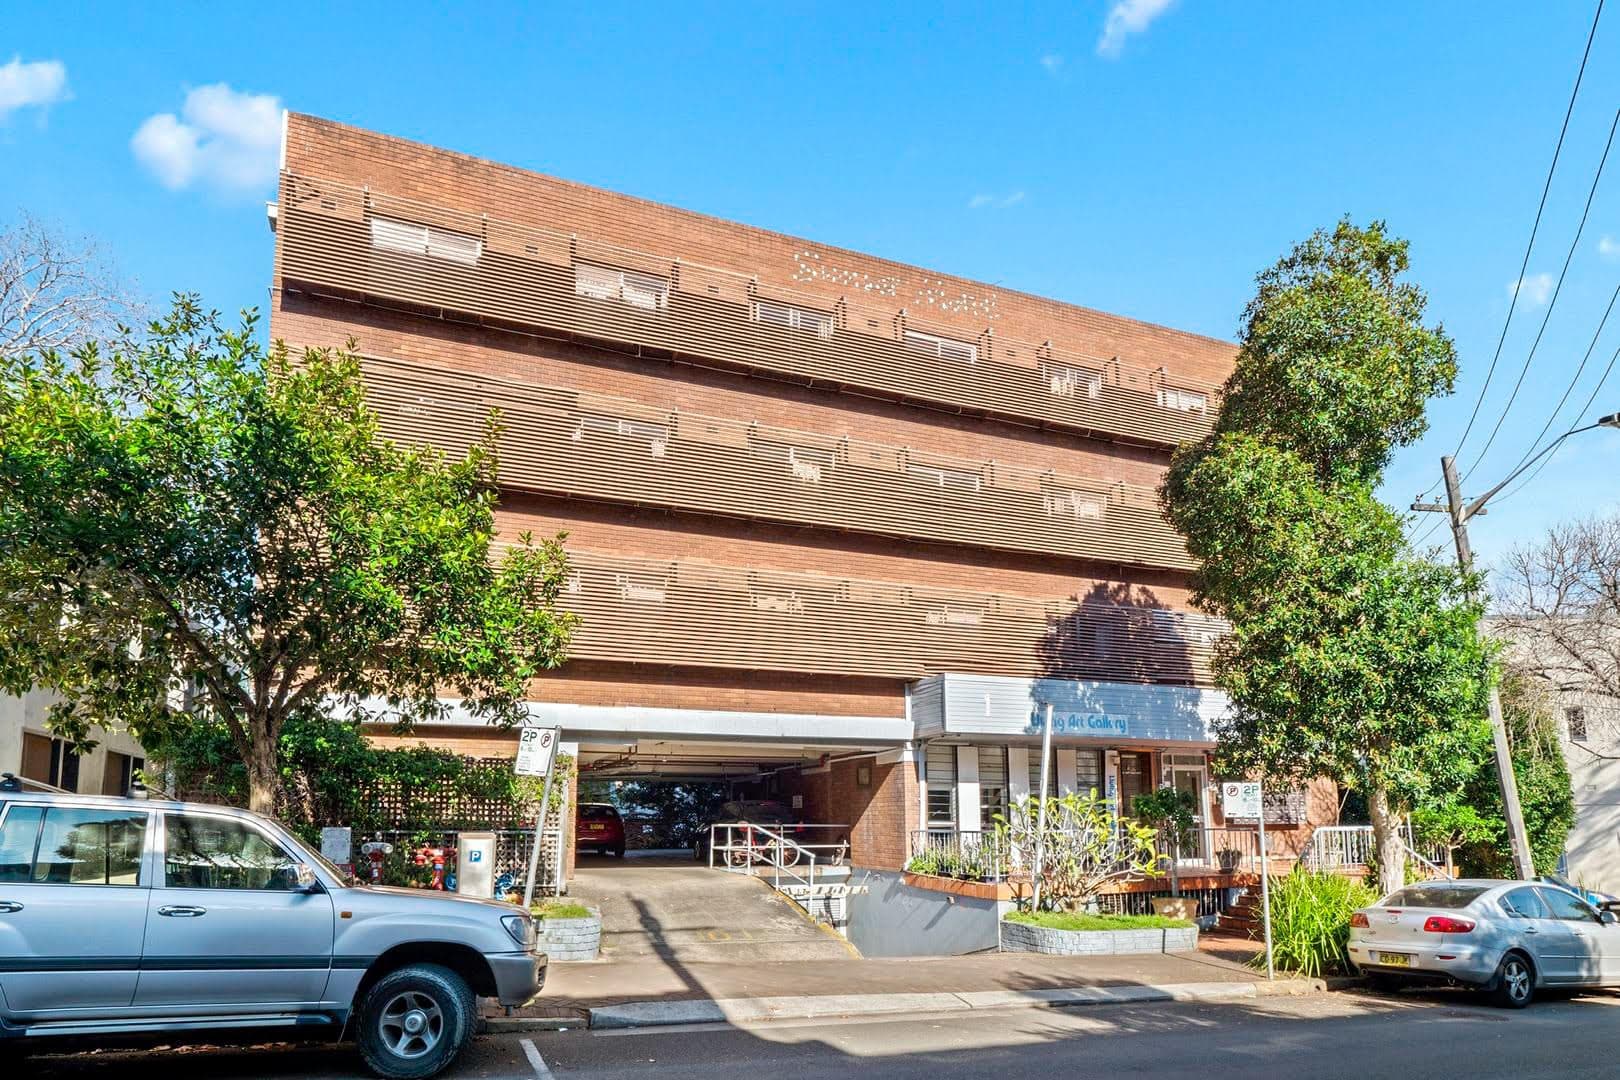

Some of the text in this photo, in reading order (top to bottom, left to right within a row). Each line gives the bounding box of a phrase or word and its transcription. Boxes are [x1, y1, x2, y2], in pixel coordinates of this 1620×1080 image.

[1030, 711, 1126, 733] Livg Art Gallery
[522, 730, 538, 742] 2P
[1243, 785, 1259, 794] 2P
